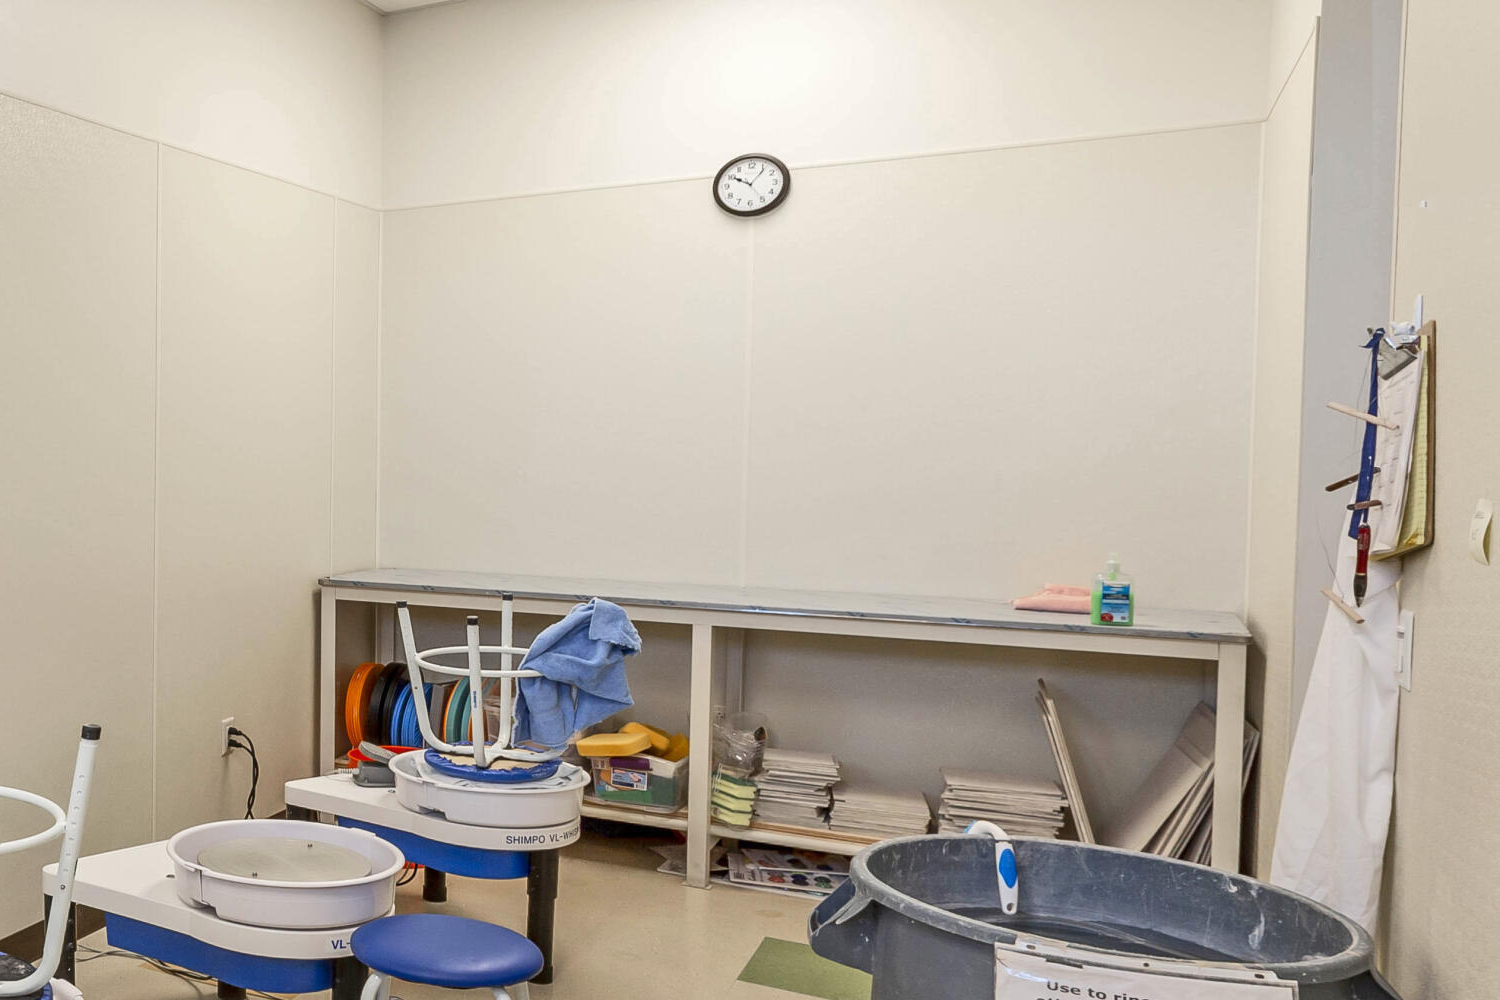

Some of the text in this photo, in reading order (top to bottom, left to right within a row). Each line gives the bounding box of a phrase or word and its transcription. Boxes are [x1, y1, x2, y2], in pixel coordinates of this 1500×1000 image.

[748, 162, 756, 170] 12
[772, 178, 778, 186] 3
[728, 192, 734, 200] 8
[747, 200, 753, 208] 6
[506, 836, 545, 844] SHIMPO
[1047, 981, 1080, 995] Use
[1088, 988, 1106, 1000] to
